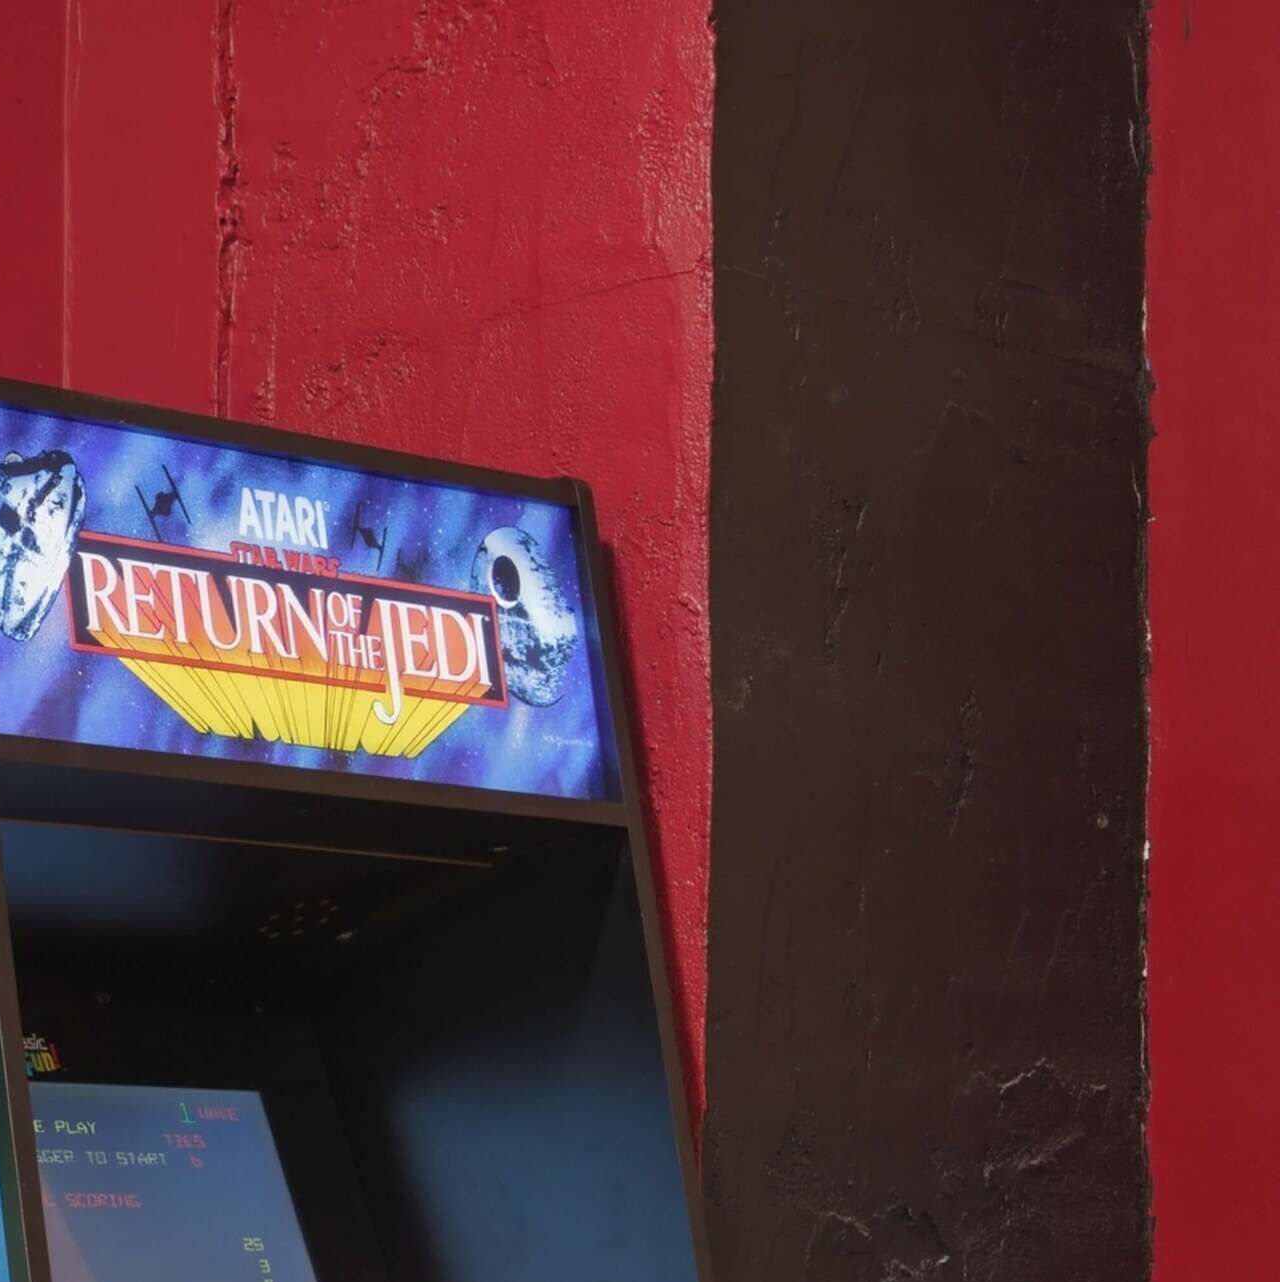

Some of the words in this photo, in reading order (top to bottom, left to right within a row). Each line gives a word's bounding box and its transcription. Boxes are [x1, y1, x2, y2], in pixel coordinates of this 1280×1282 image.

[239, 487, 328, 550] ATARI
[76, 550, 328, 673] RETURN
[326, 590, 364, 633] OF
[327, 627, 384, 673] THE
[371, 596, 494, 725] JEDI
[178, 1101, 196, 1124] 1
[54, 1120, 97, 1135] PLAY
[88, 1151, 108, 1165] TO
[116, 1152, 167, 1166] START
[64, 1192, 142, 1208] SCORING
[243, 1237, 265, 1252] 25
[259, 1258, 272, 1274] 3
